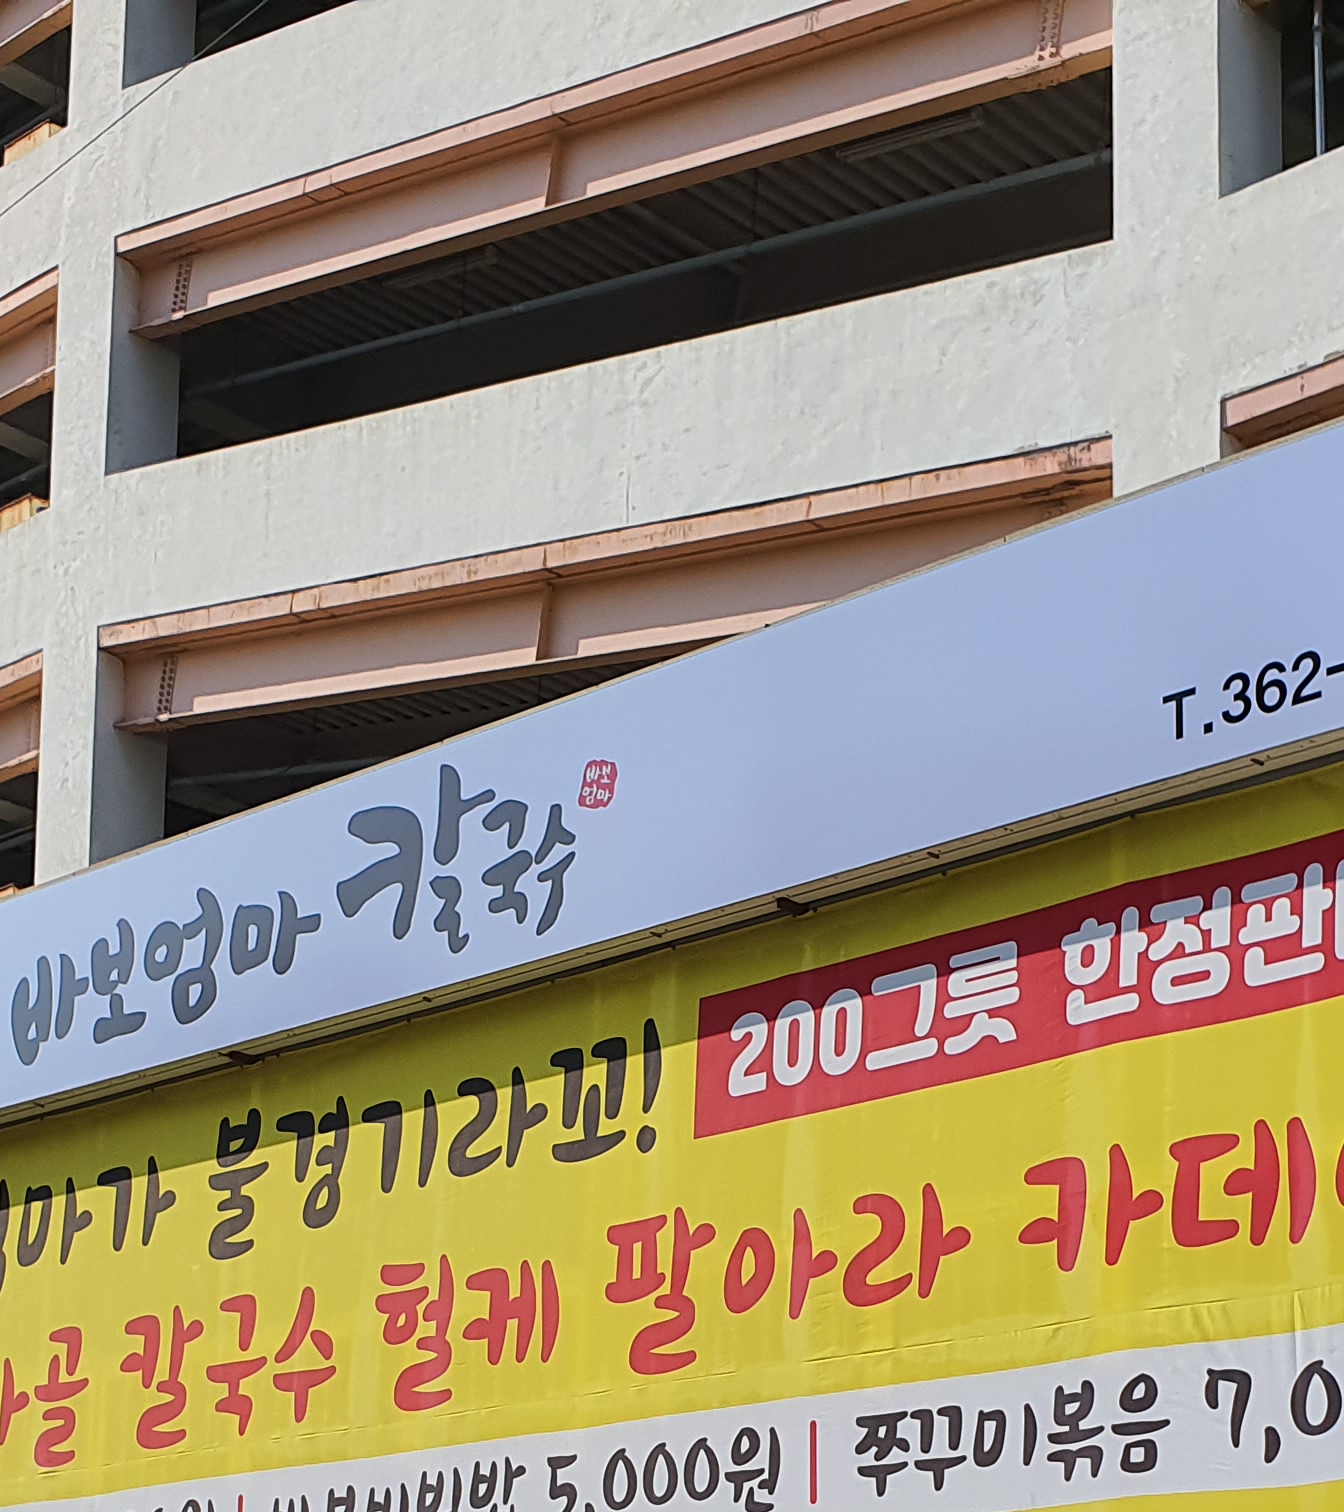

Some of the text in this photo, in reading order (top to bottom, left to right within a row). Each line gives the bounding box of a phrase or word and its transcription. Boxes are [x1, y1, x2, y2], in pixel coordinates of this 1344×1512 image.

[581, 784, 613, 806] 엄마
[585, 764, 613, 784] 바보
[9, 763, 577, 1066] 바보엄마 칼국수
[726, 939, 1021, 1099] 200그릇
[208, 1016, 664, 1261] 불경기라꼬!
[118, 1285, 338, 1451] 칼국수
[604, 1181, 971, 1377] 팔아라
[854, 1372, 1171, 1498] 쭈꾸미볶음
